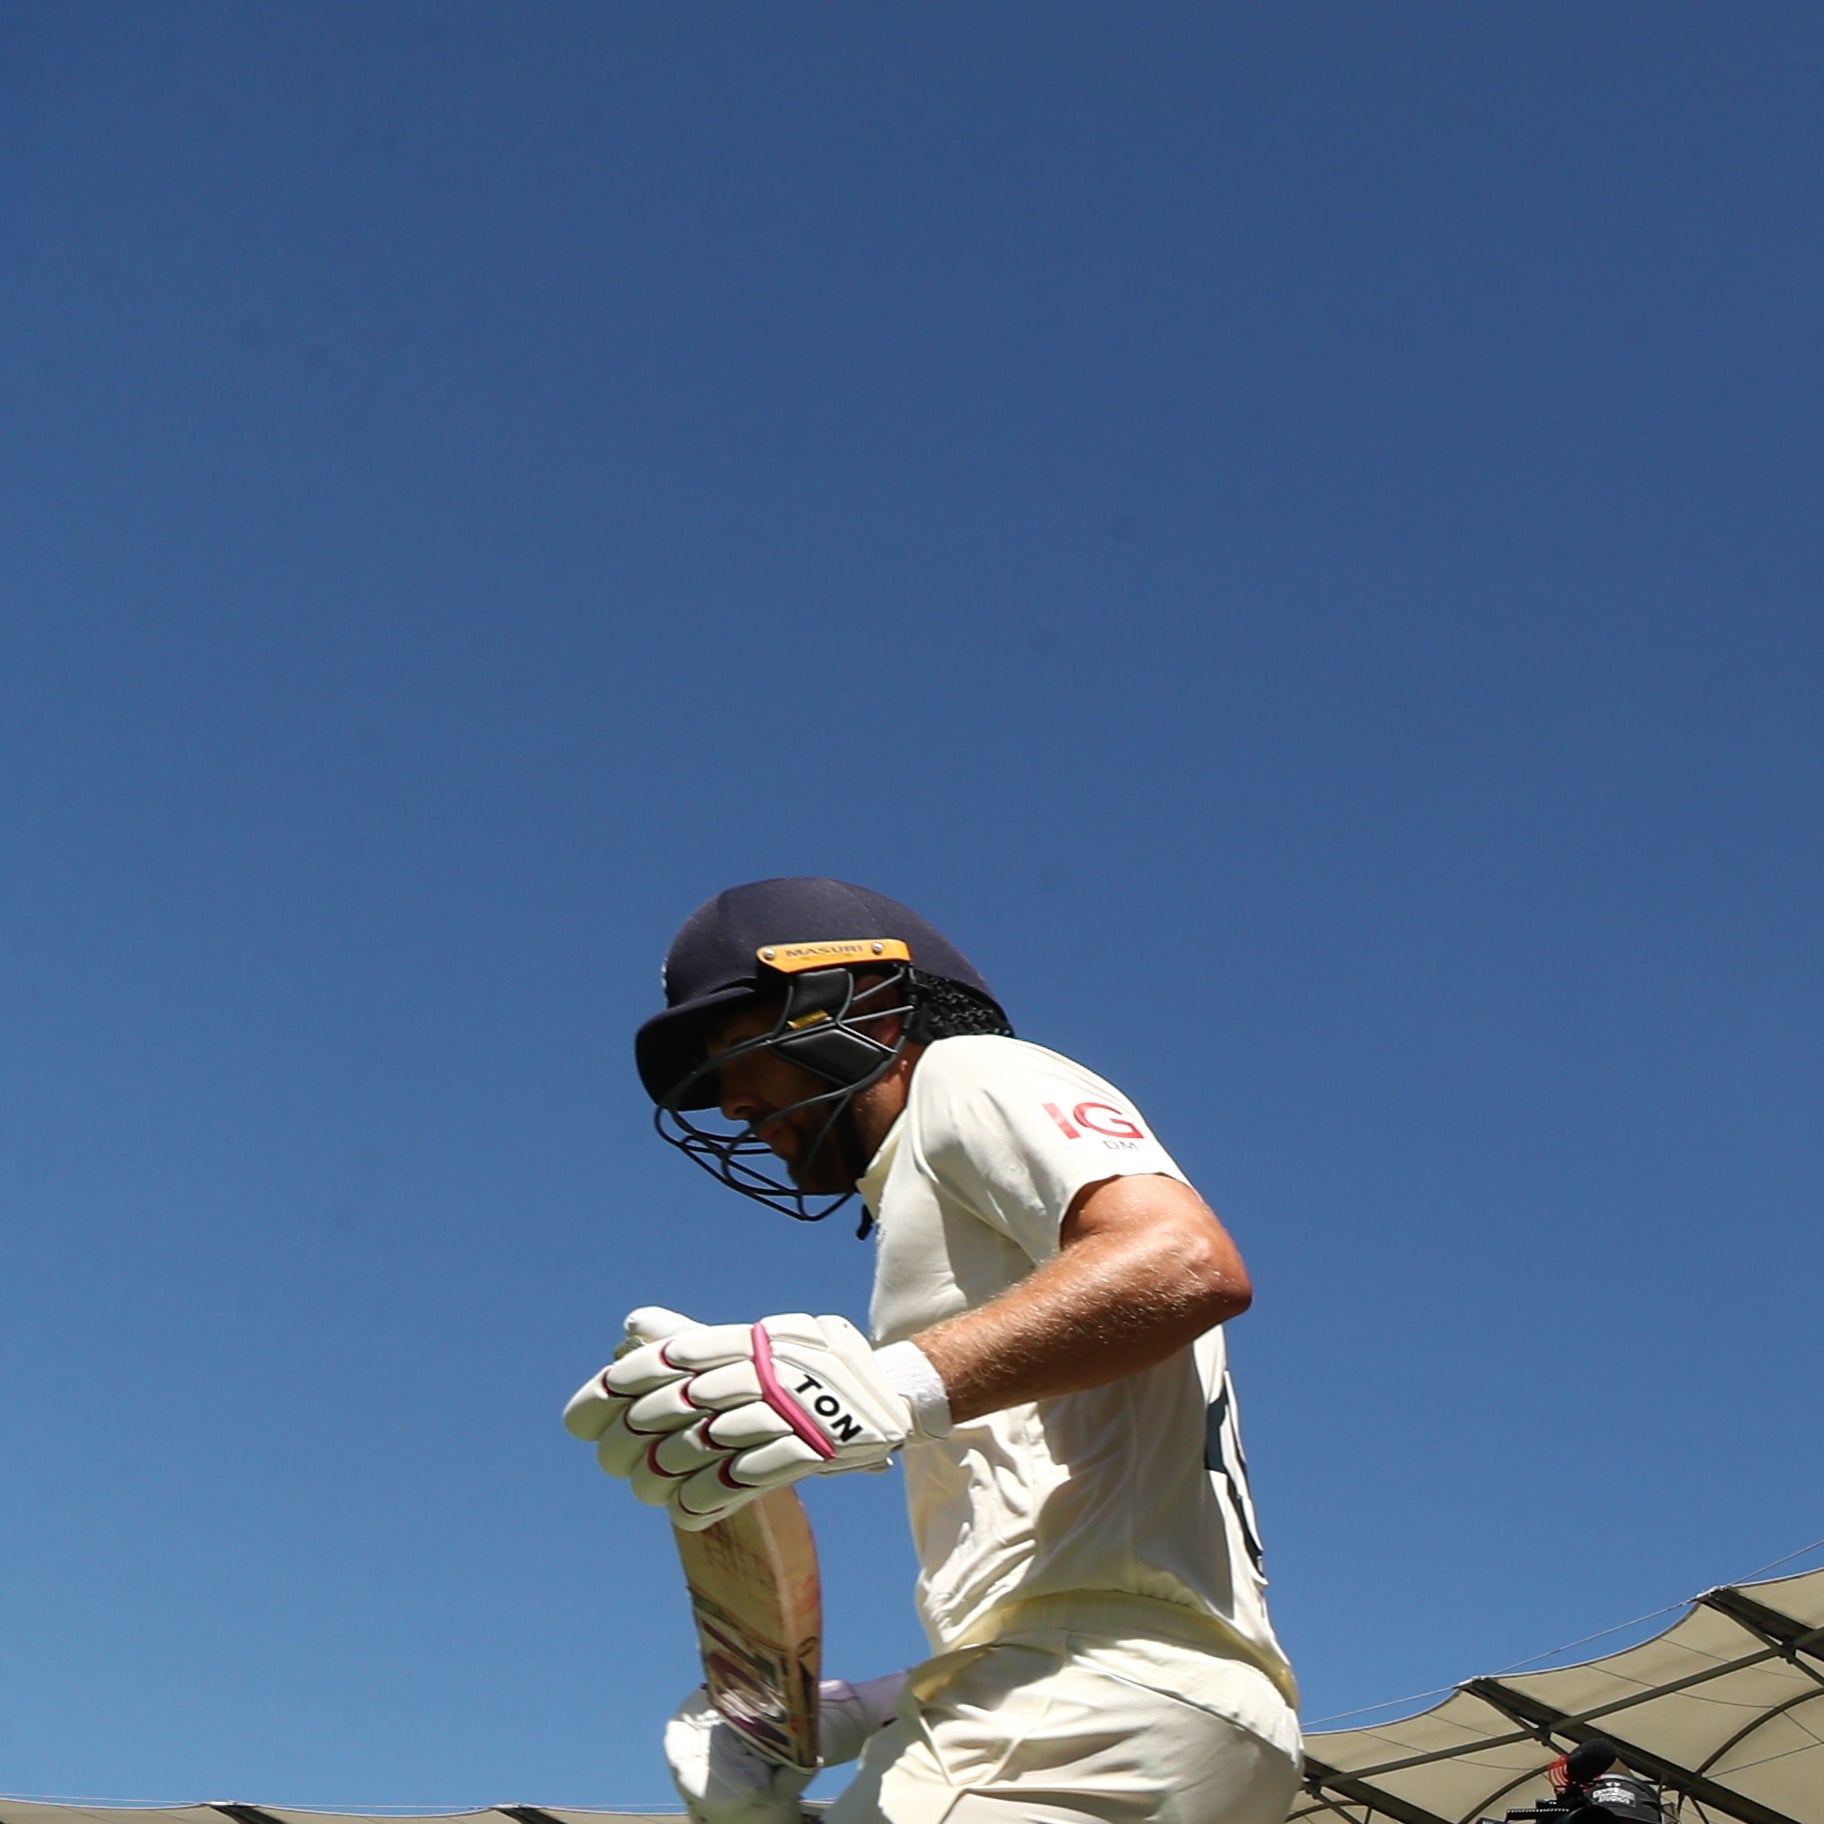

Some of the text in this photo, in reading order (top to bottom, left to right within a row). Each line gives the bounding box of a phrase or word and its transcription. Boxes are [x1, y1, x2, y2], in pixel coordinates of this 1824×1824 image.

[786, 945, 863, 958] MASURI
[1041, 1101, 1145, 1140] IG
[794, 1373, 863, 1442] TON
